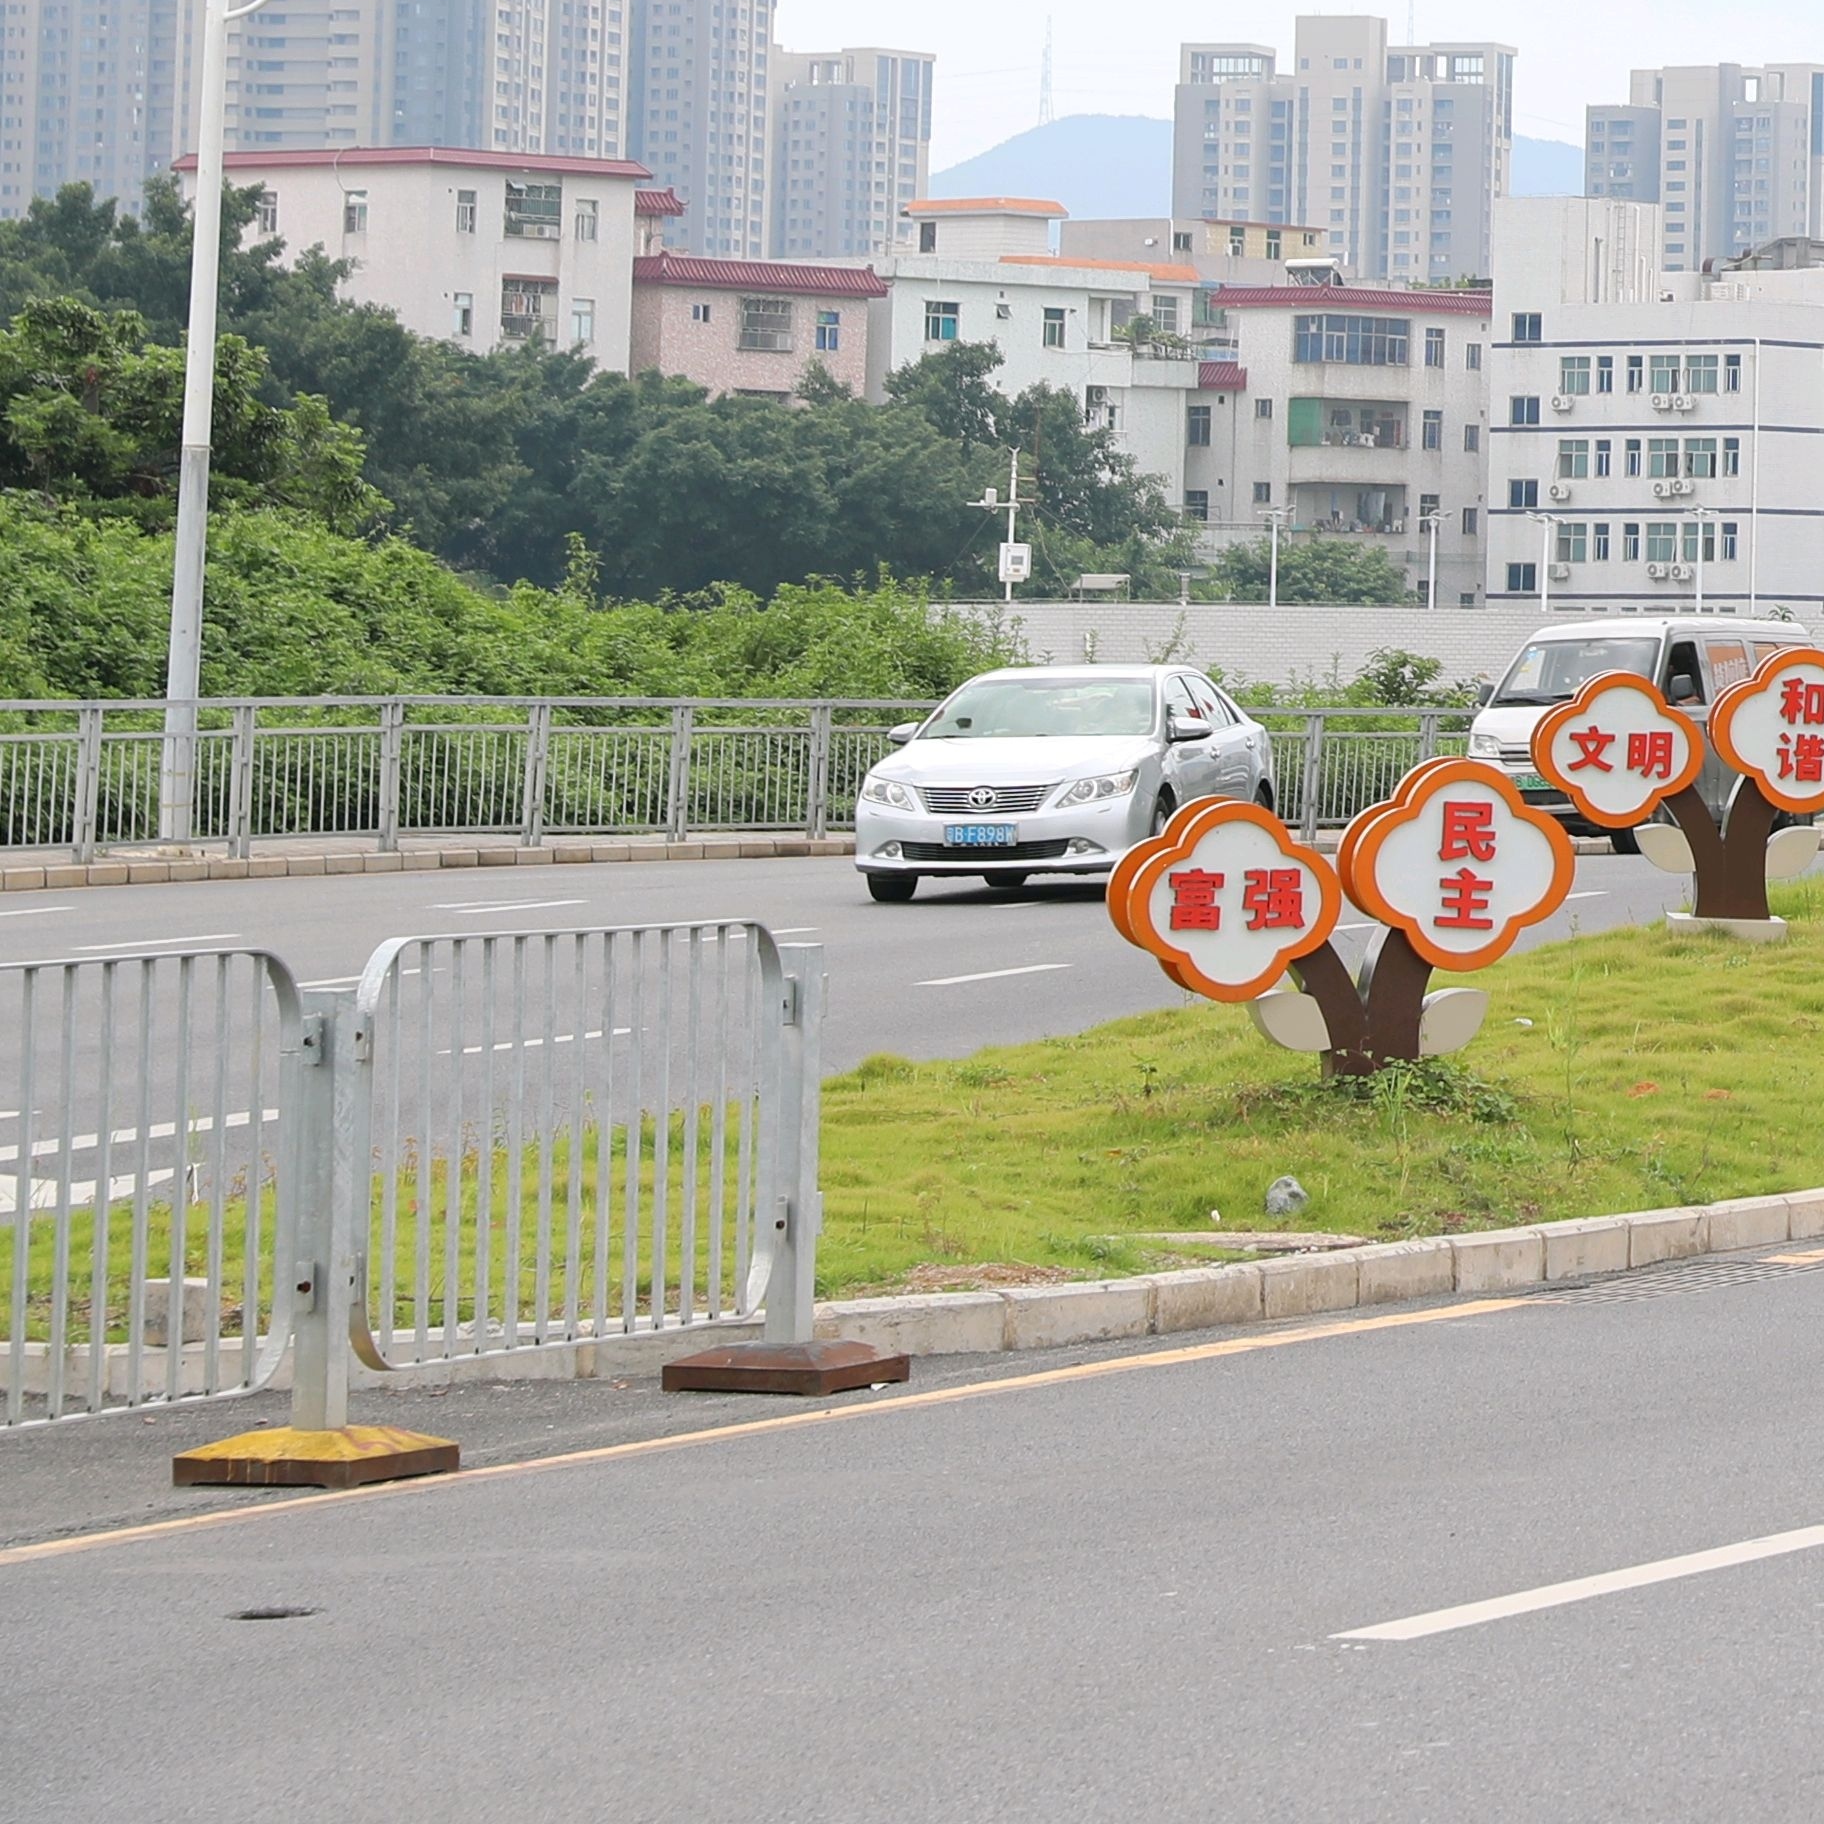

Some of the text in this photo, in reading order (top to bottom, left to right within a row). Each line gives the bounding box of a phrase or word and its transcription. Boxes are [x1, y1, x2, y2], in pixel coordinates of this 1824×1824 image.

[1568, 725, 1674, 779] 文明
[1433, 801, 1496, 930] 民主
[1169, 868, 1305, 932] 富强
